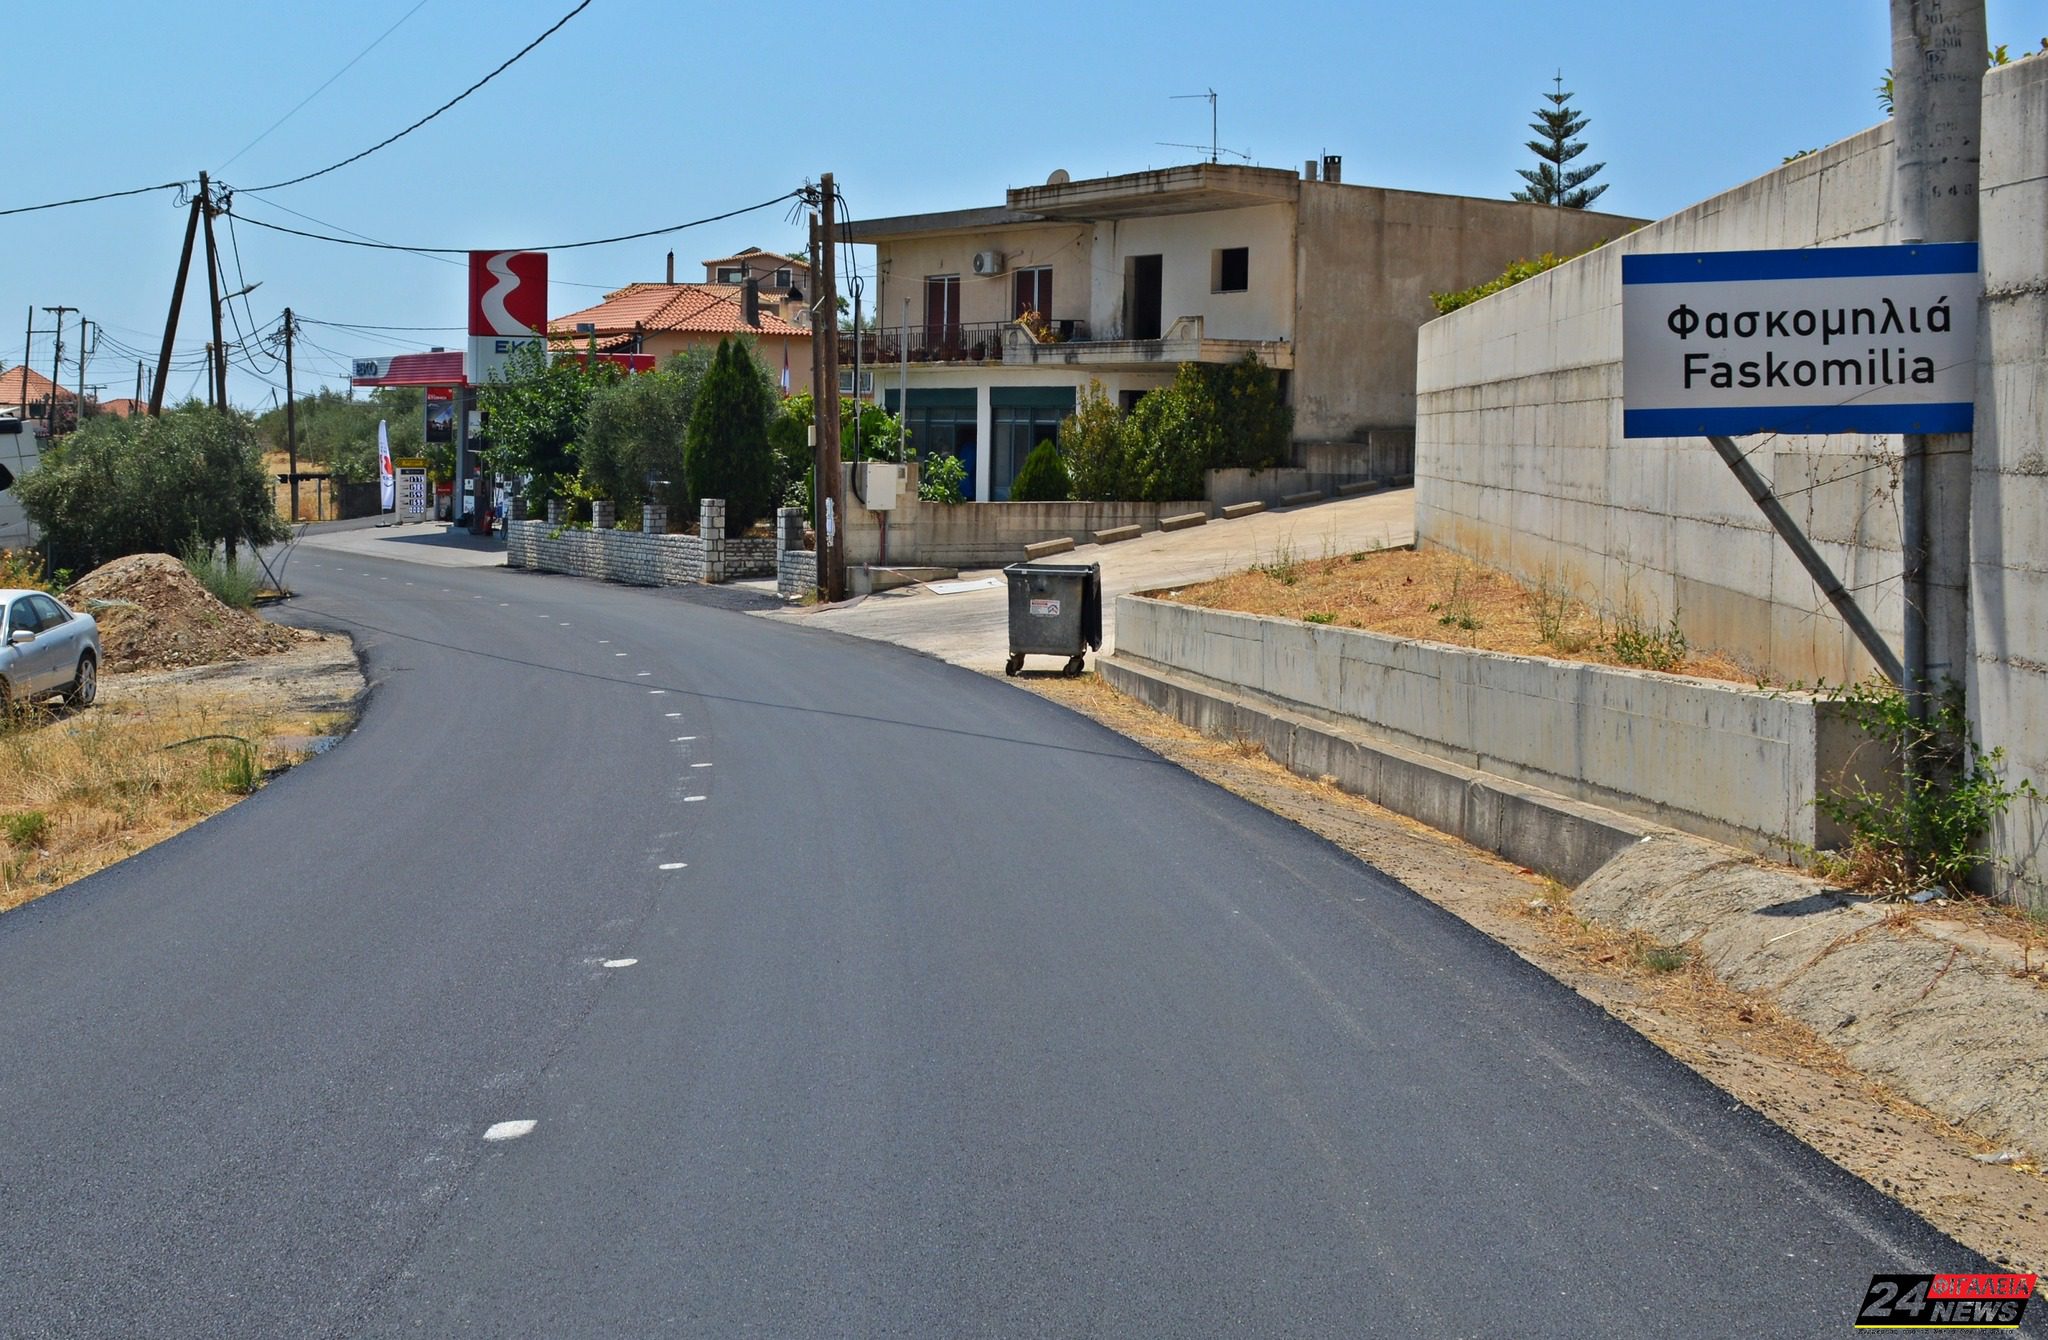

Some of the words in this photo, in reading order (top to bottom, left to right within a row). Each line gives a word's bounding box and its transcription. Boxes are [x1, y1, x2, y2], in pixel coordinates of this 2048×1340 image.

[1667, 296, 1951, 345] Φασκομηλιά
[356, 361, 378, 376] EKO
[1684, 348, 1934, 389] Faskomilia
